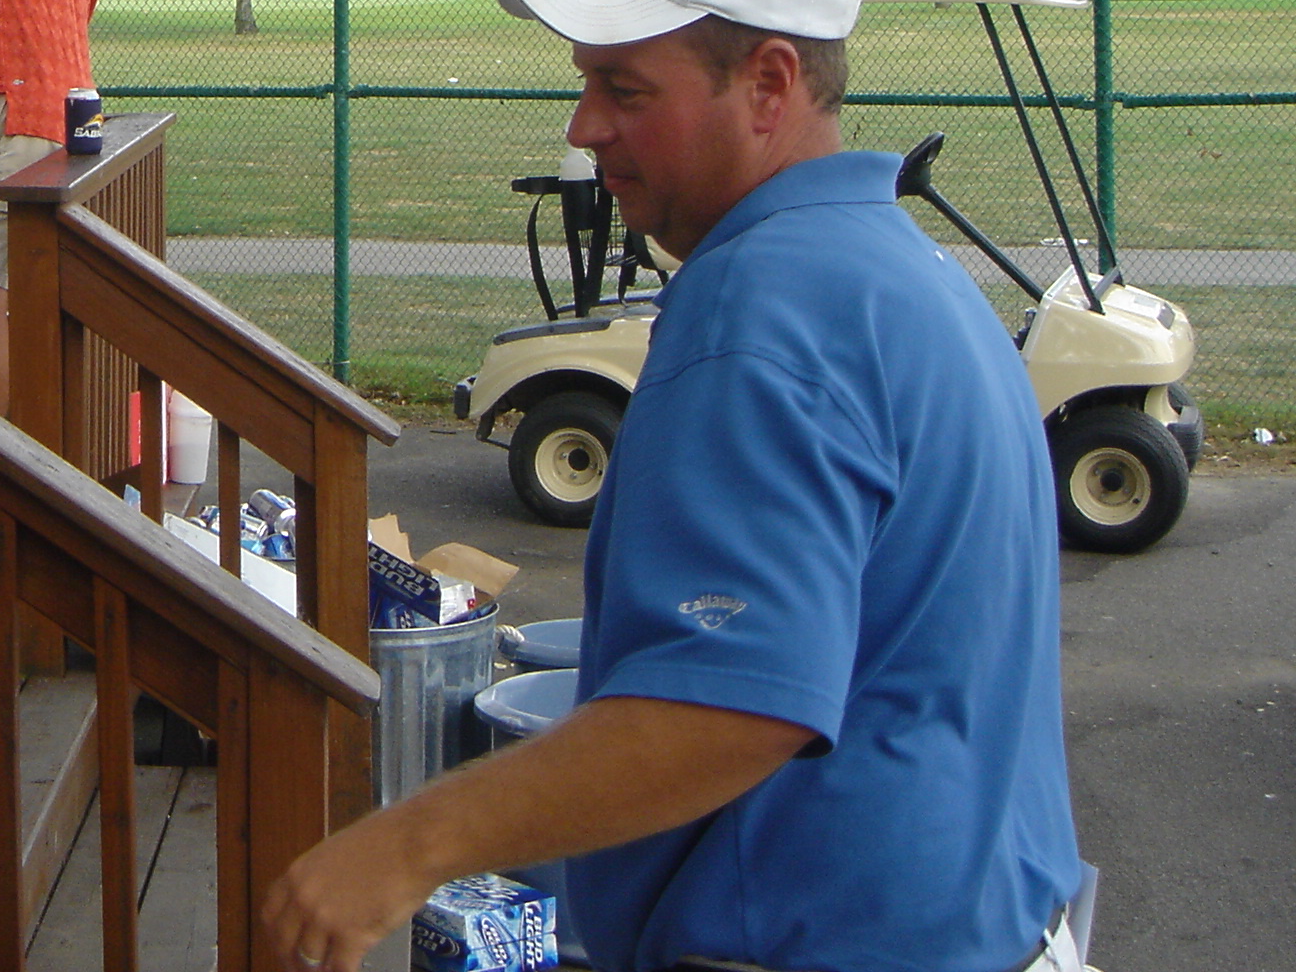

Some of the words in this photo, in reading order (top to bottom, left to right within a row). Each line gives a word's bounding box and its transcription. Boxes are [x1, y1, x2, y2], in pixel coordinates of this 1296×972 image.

[369, 546, 439, 592] LIGHT
[369, 561, 425, 596] BUD
[525, 906, 535, 970] LIGHT
[533, 915, 544, 964] BUD
